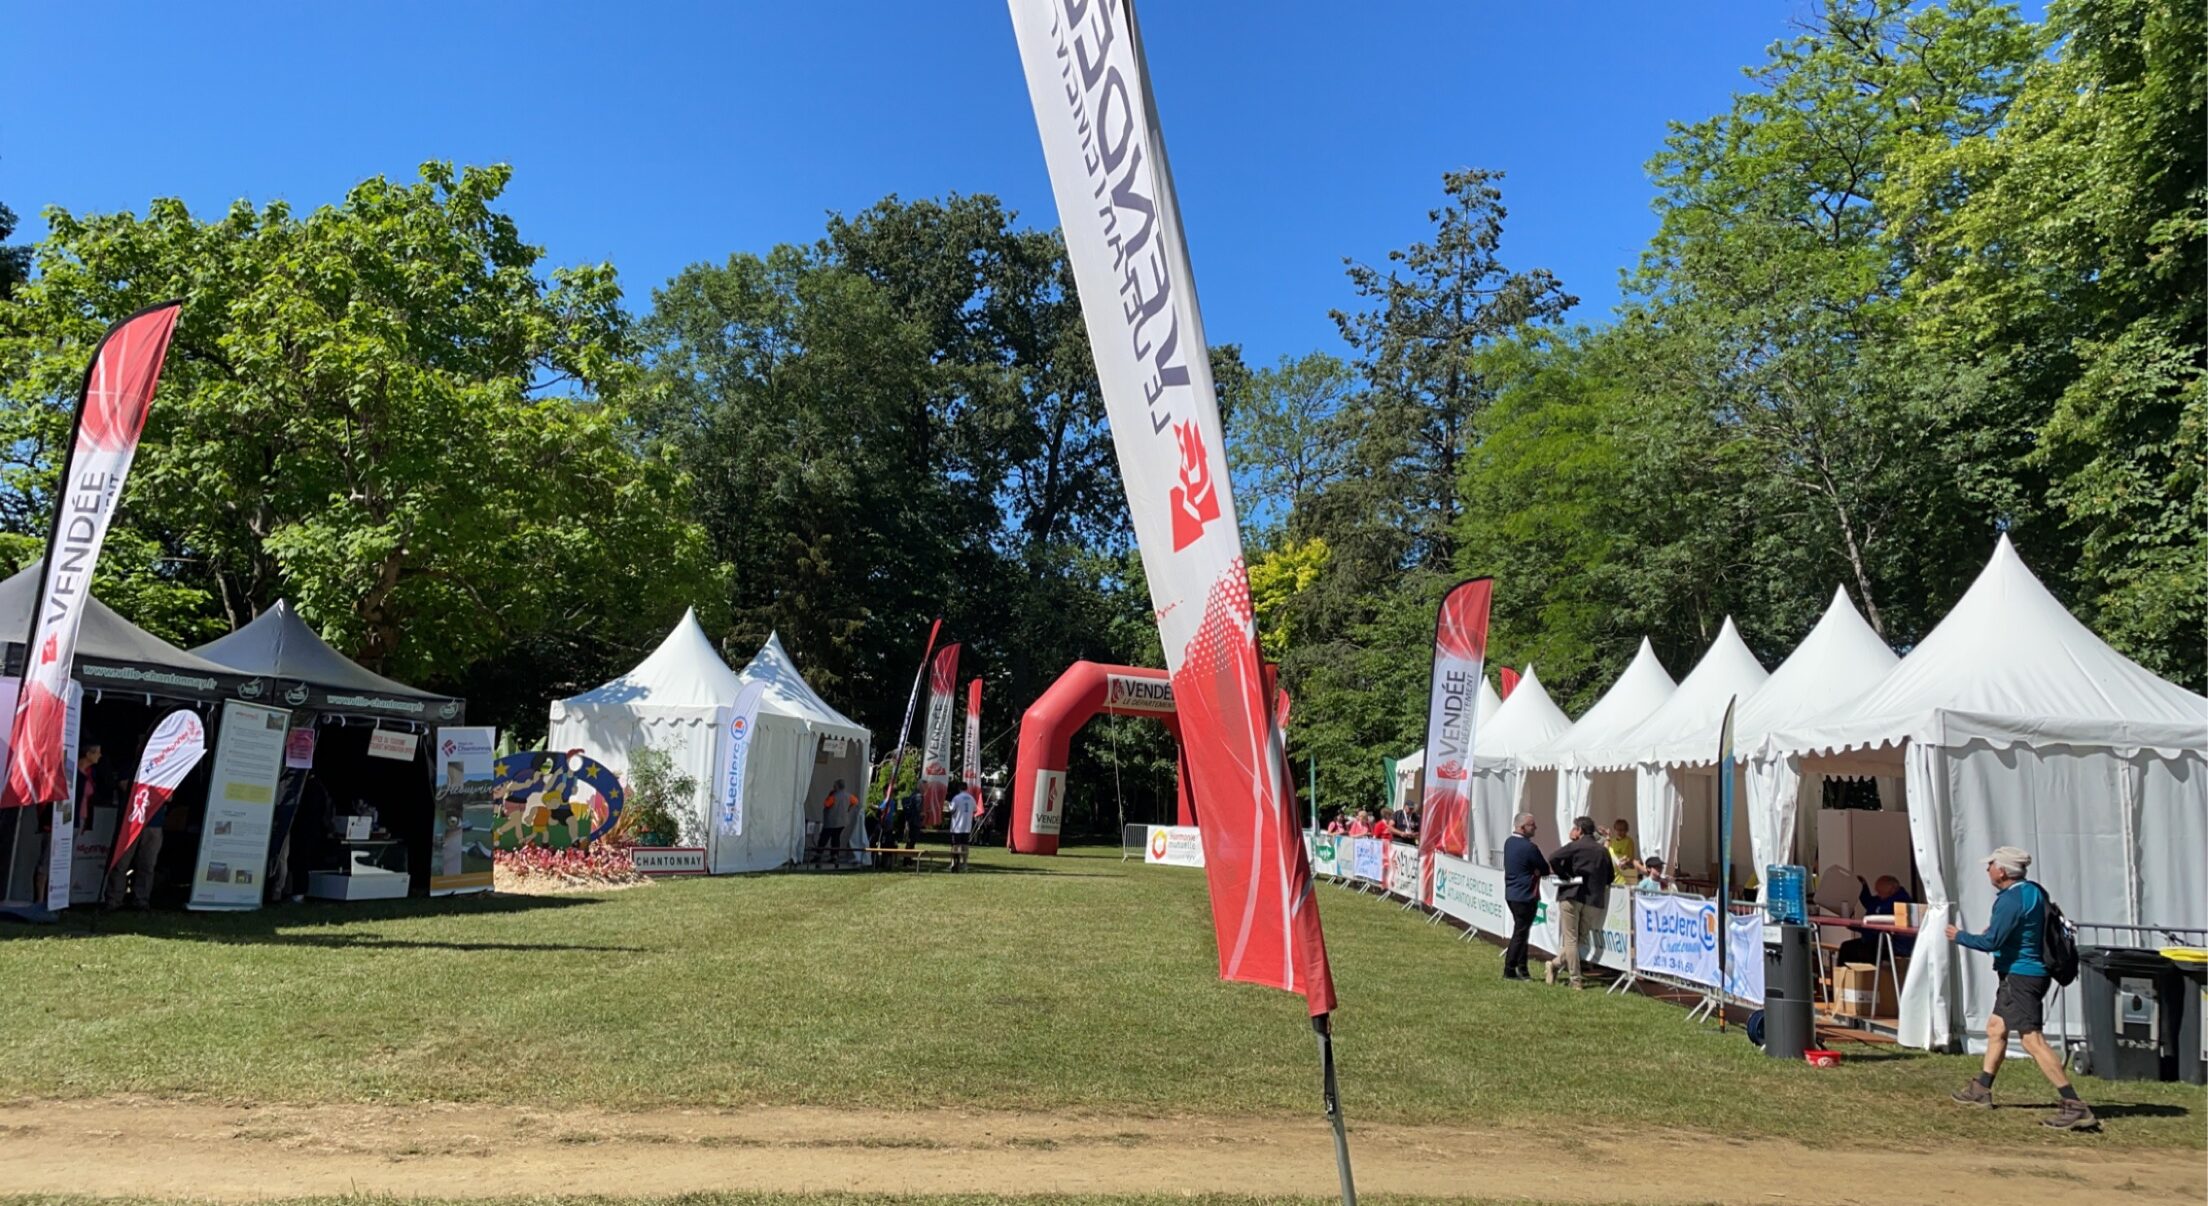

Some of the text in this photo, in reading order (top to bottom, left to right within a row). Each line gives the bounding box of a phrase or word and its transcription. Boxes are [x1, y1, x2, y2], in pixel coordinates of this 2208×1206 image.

[47, 471, 105, 626] VENDÉE
[1125, 679, 1174, 701] VENDÉ
[1438, 670, 1467, 757] VENDÉE
[636, 855, 702, 867] CHANTONNAY
